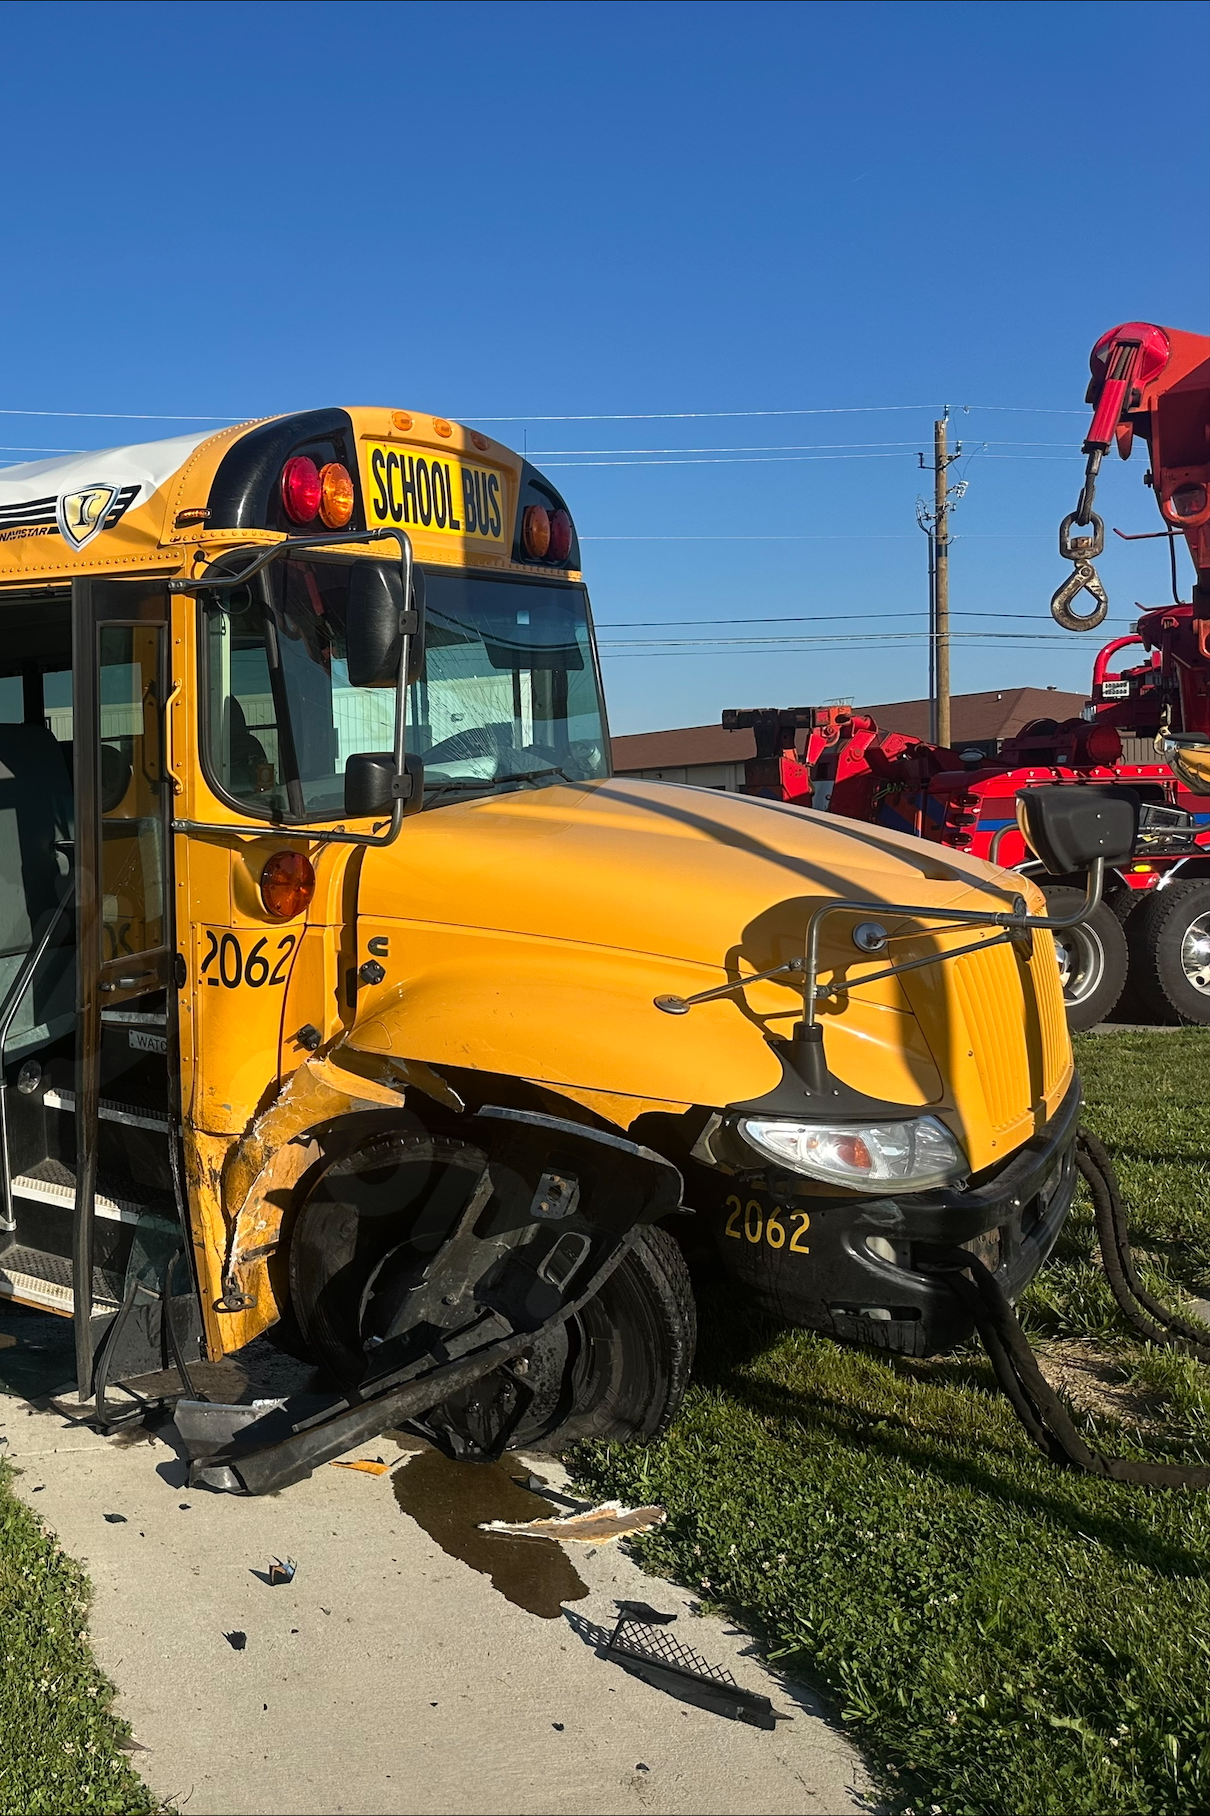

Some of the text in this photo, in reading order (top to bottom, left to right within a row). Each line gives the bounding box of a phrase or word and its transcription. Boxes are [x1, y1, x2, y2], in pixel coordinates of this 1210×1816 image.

[372, 448, 502, 538] SCHOOL BUS
[200, 930, 296, 989] 2062
[137, 1034, 167, 1052] WATC
[725, 1194, 810, 1254] 2062
